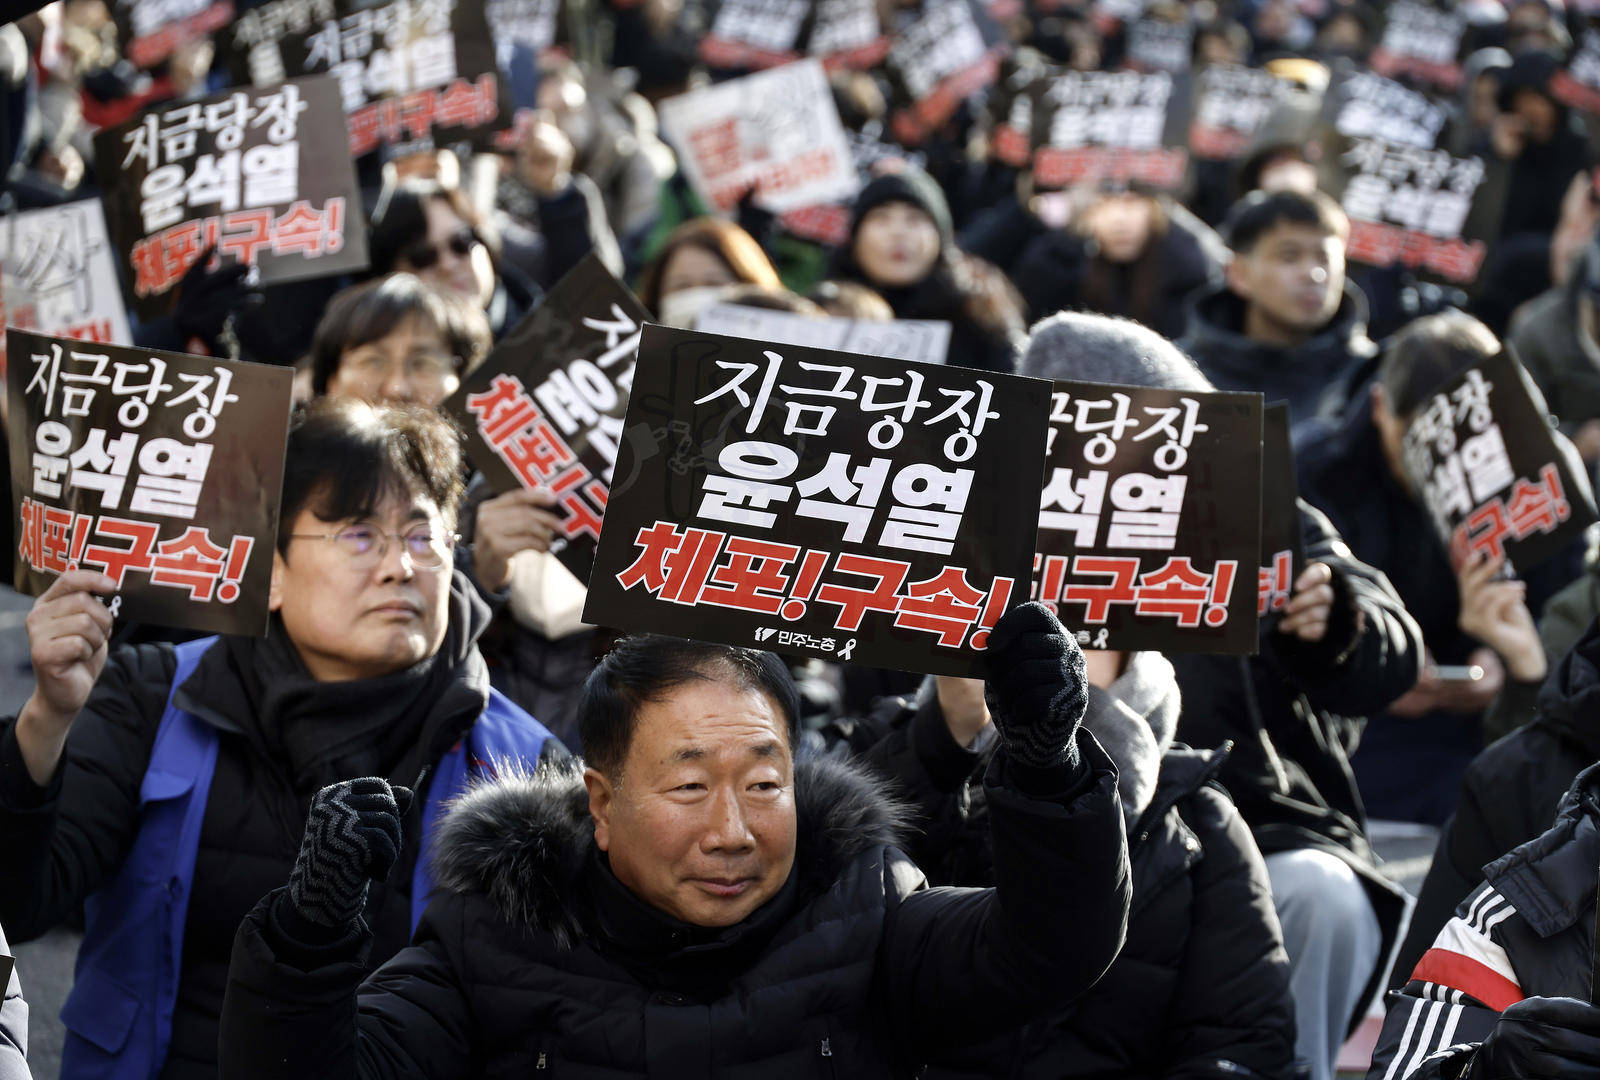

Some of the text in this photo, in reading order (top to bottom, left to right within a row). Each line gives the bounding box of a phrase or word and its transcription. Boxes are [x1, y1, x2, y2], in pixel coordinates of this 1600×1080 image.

[121, 84, 308, 170] 지금당장
[141, 140, 299, 235] 윤석열
[25, 343, 239, 439] 지금당장
[694, 350, 1000, 462] 지금당장
[32, 420, 214, 520] 윤석열
[696, 441, 976, 556] 윤석열
[1038, 467, 1188, 550] 석열
[778, 630, 837, 652] 민주노총
